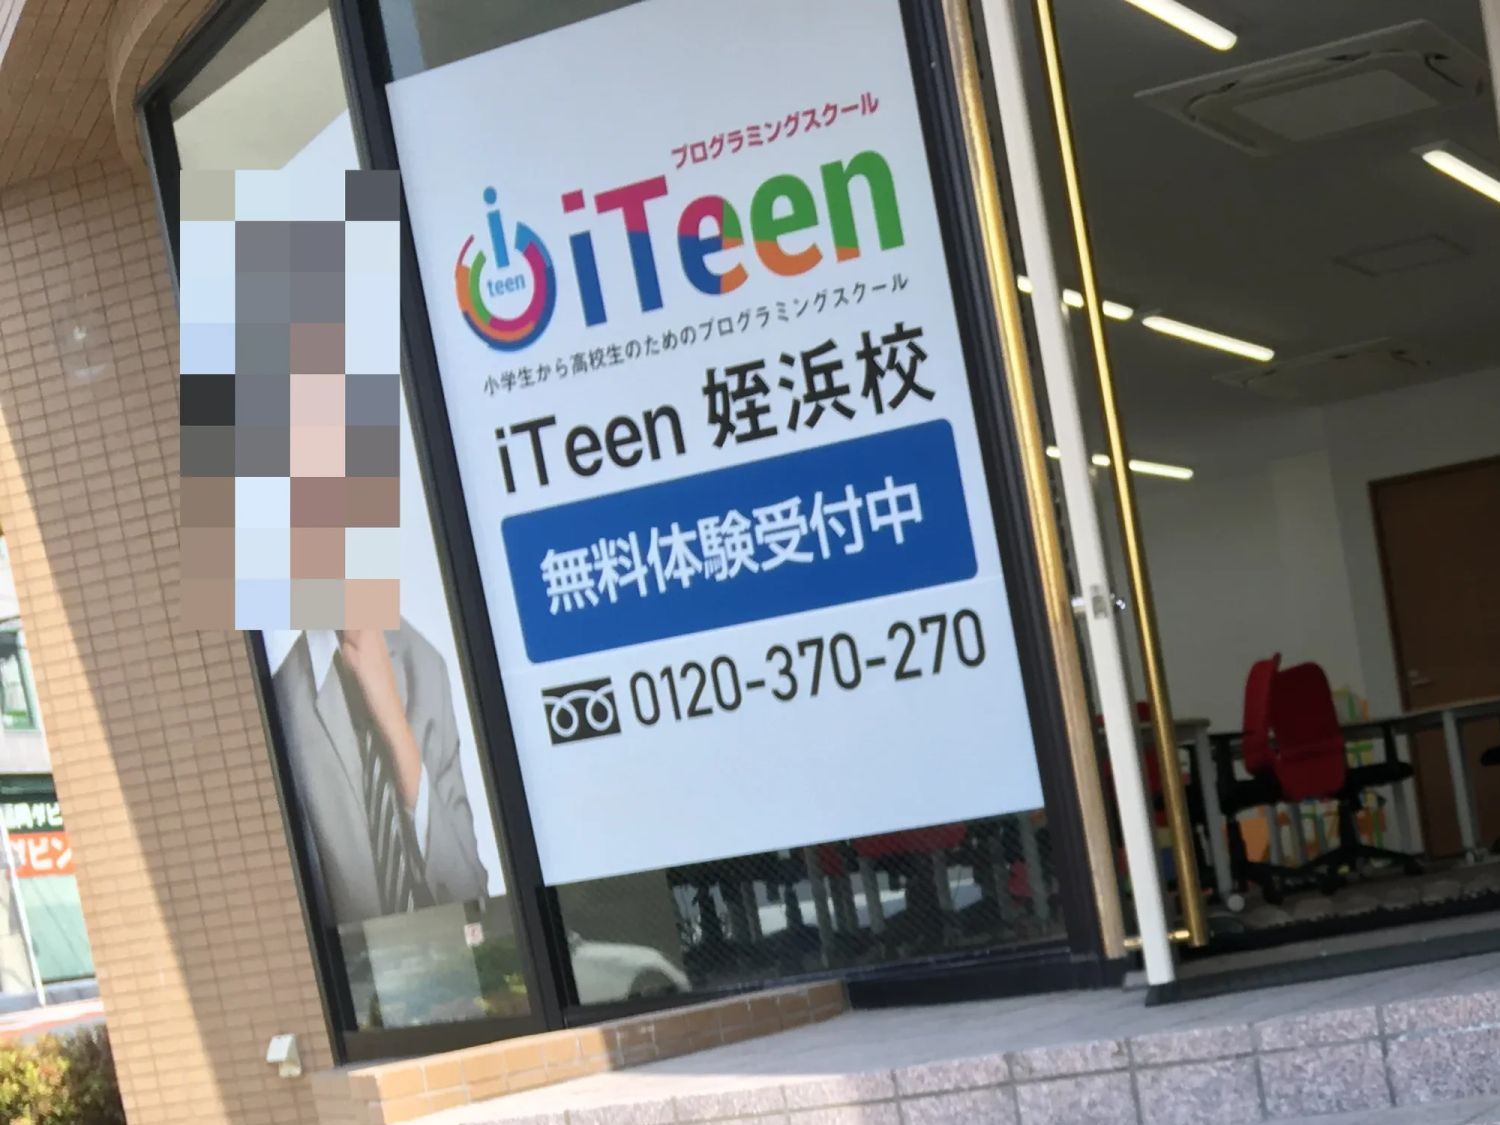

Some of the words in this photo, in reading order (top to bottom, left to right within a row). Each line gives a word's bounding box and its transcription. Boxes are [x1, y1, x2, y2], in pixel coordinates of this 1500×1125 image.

[672, 92, 879, 169] プログラミングスクール
[486, 272, 528, 298] teen
[561, 149, 905, 328] iTeen
[483, 273, 909, 396] 小学生から高校生のためのプログラミングスクール
[495, 404, 685, 493] iTeen
[702, 321, 936, 449] 姪浜校
[540, 476, 924, 615] 無料体験受付中
[629, 608, 987, 726] 0120-370-270
